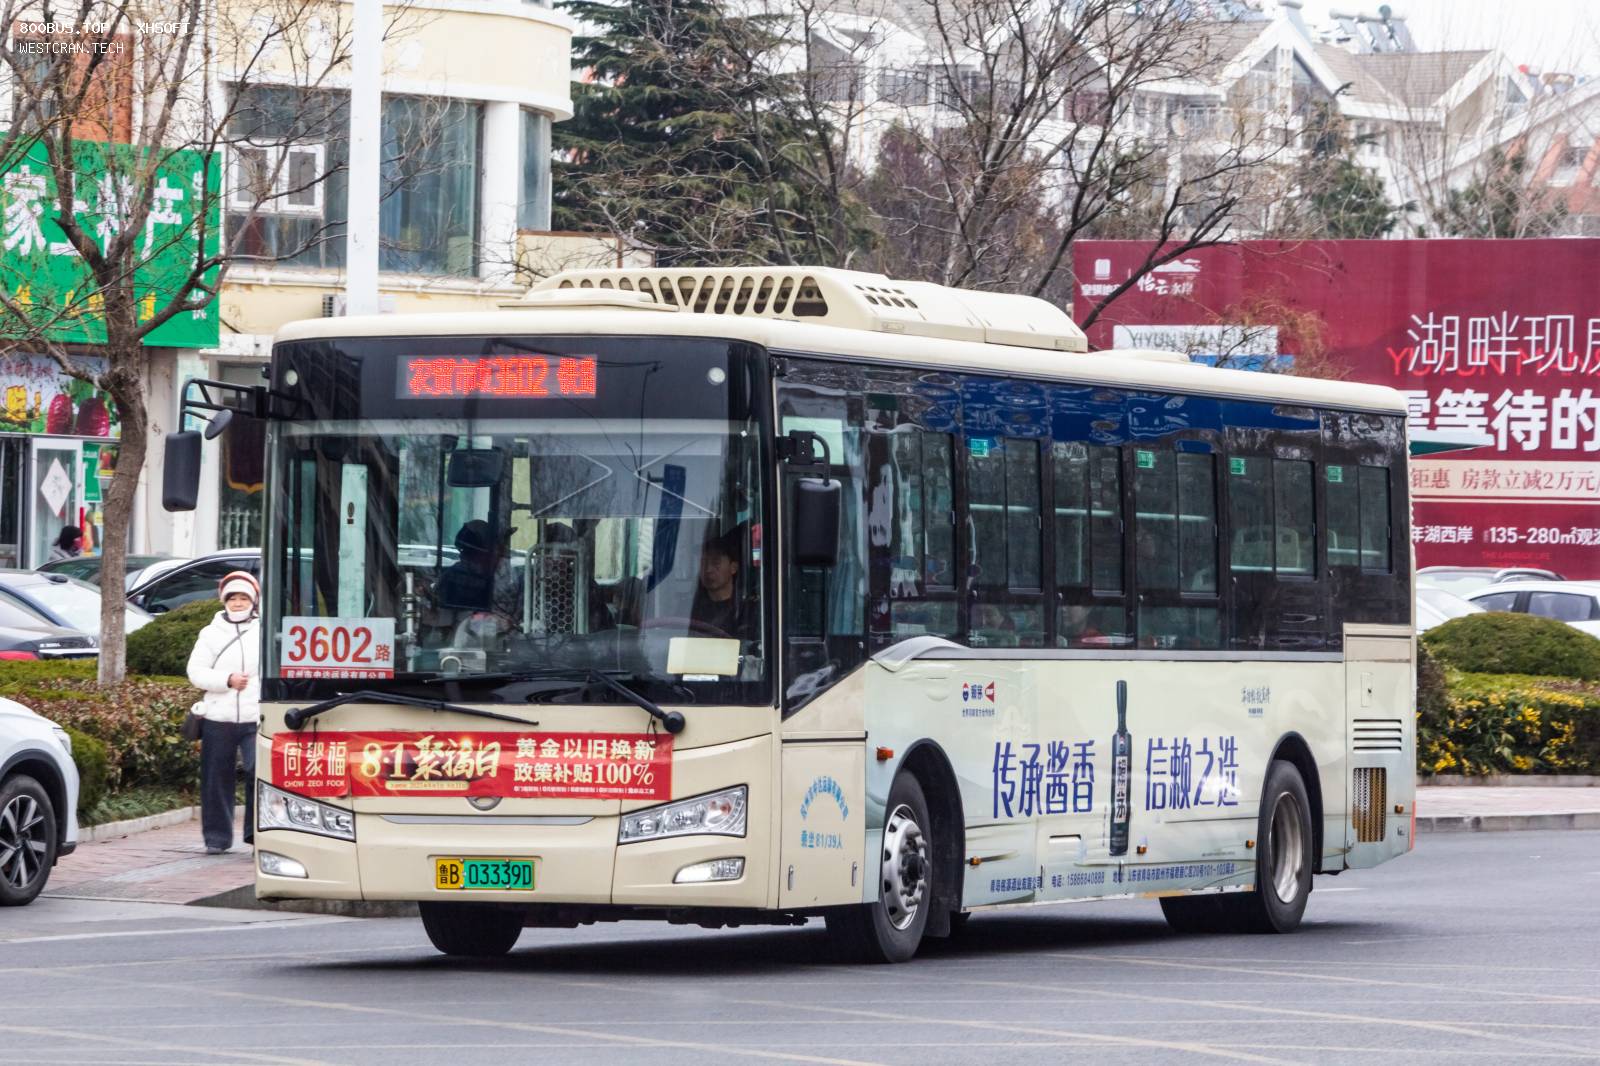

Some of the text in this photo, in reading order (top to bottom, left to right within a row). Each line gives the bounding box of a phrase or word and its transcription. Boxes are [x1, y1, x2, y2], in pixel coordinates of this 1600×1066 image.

[515, 738, 656, 761] 黄金以旧换新
[514, 762, 655, 785] 政策补贴100%
[993, 740, 1096, 819] 传承酱香
[1145, 736, 1239, 811] 信赖之选
[468, 863, 532, 886] 03339D
